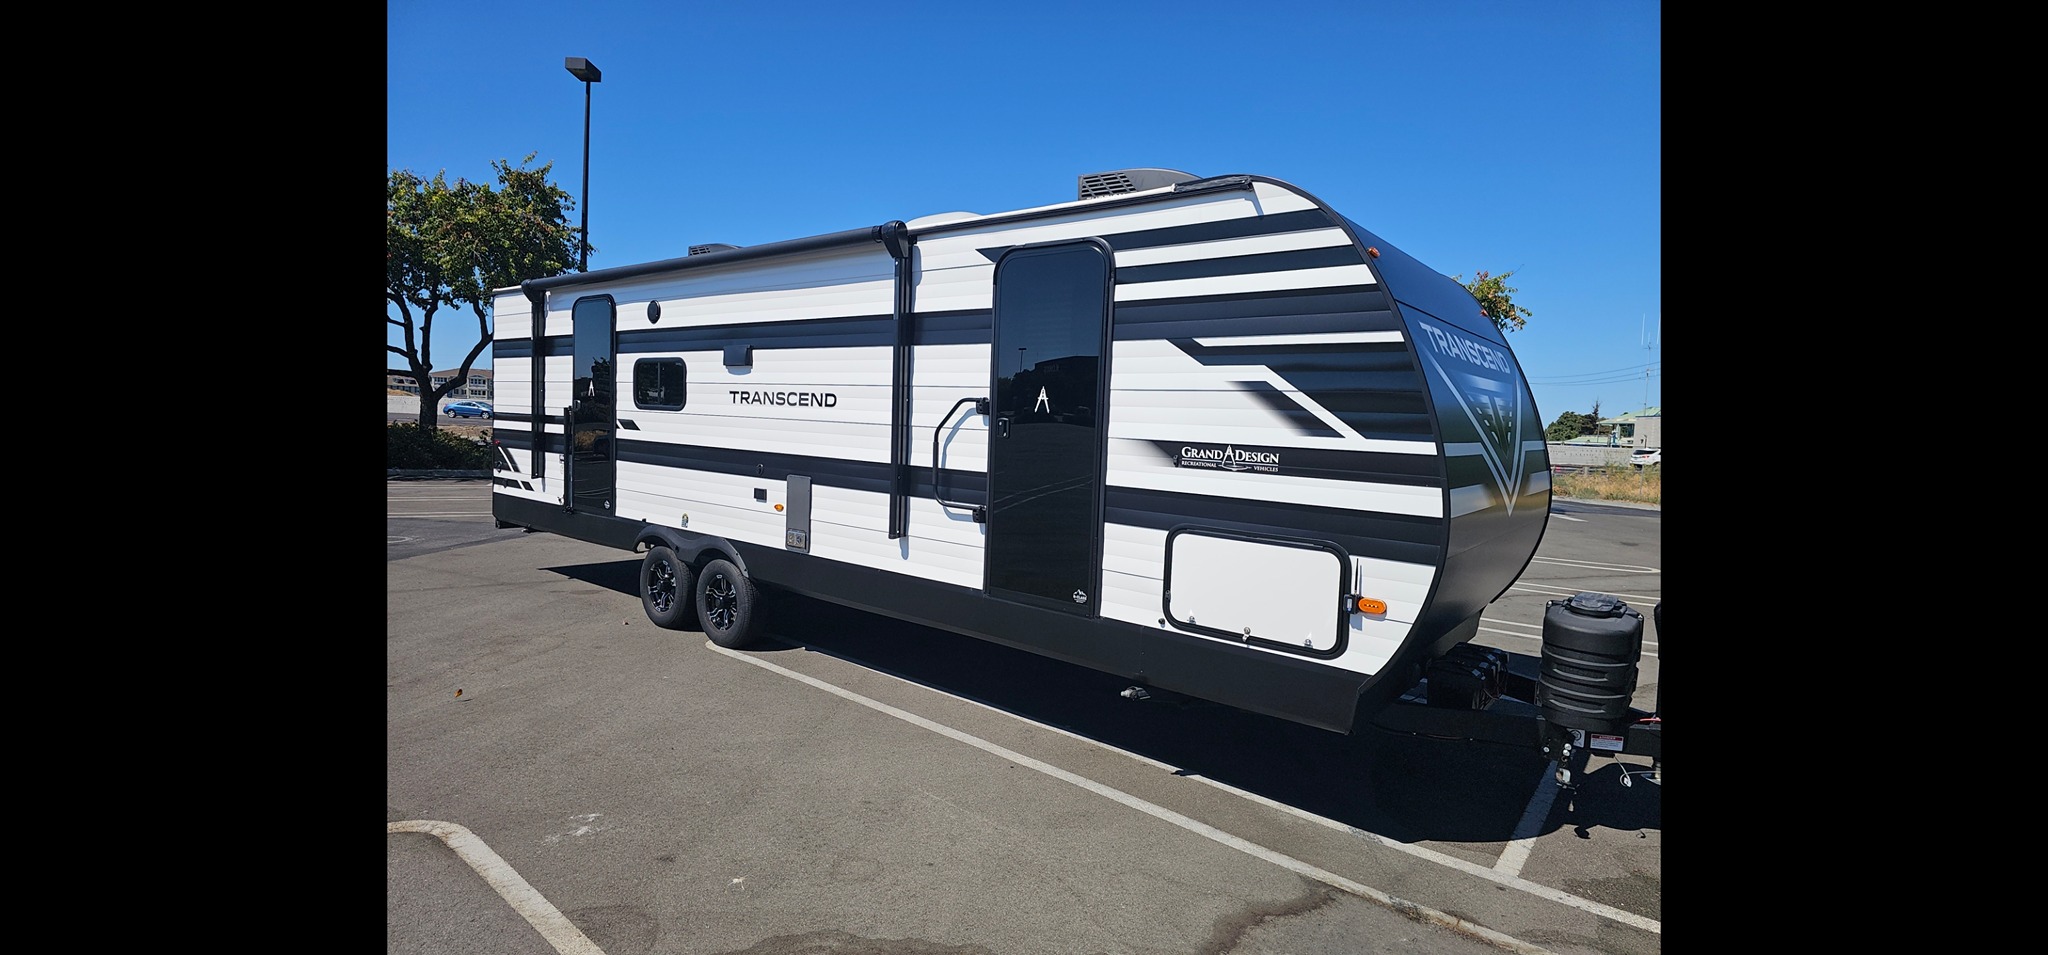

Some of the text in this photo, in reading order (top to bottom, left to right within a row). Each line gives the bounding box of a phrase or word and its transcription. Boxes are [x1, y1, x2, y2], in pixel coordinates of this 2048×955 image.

[1418, 320, 1510, 374] TRANSCEND
[729, 390, 838, 408] TRANSCEND
[1181, 446, 1280, 464] GRAND DESIGN
[1181, 460, 1217, 468] RECREATIONAL
